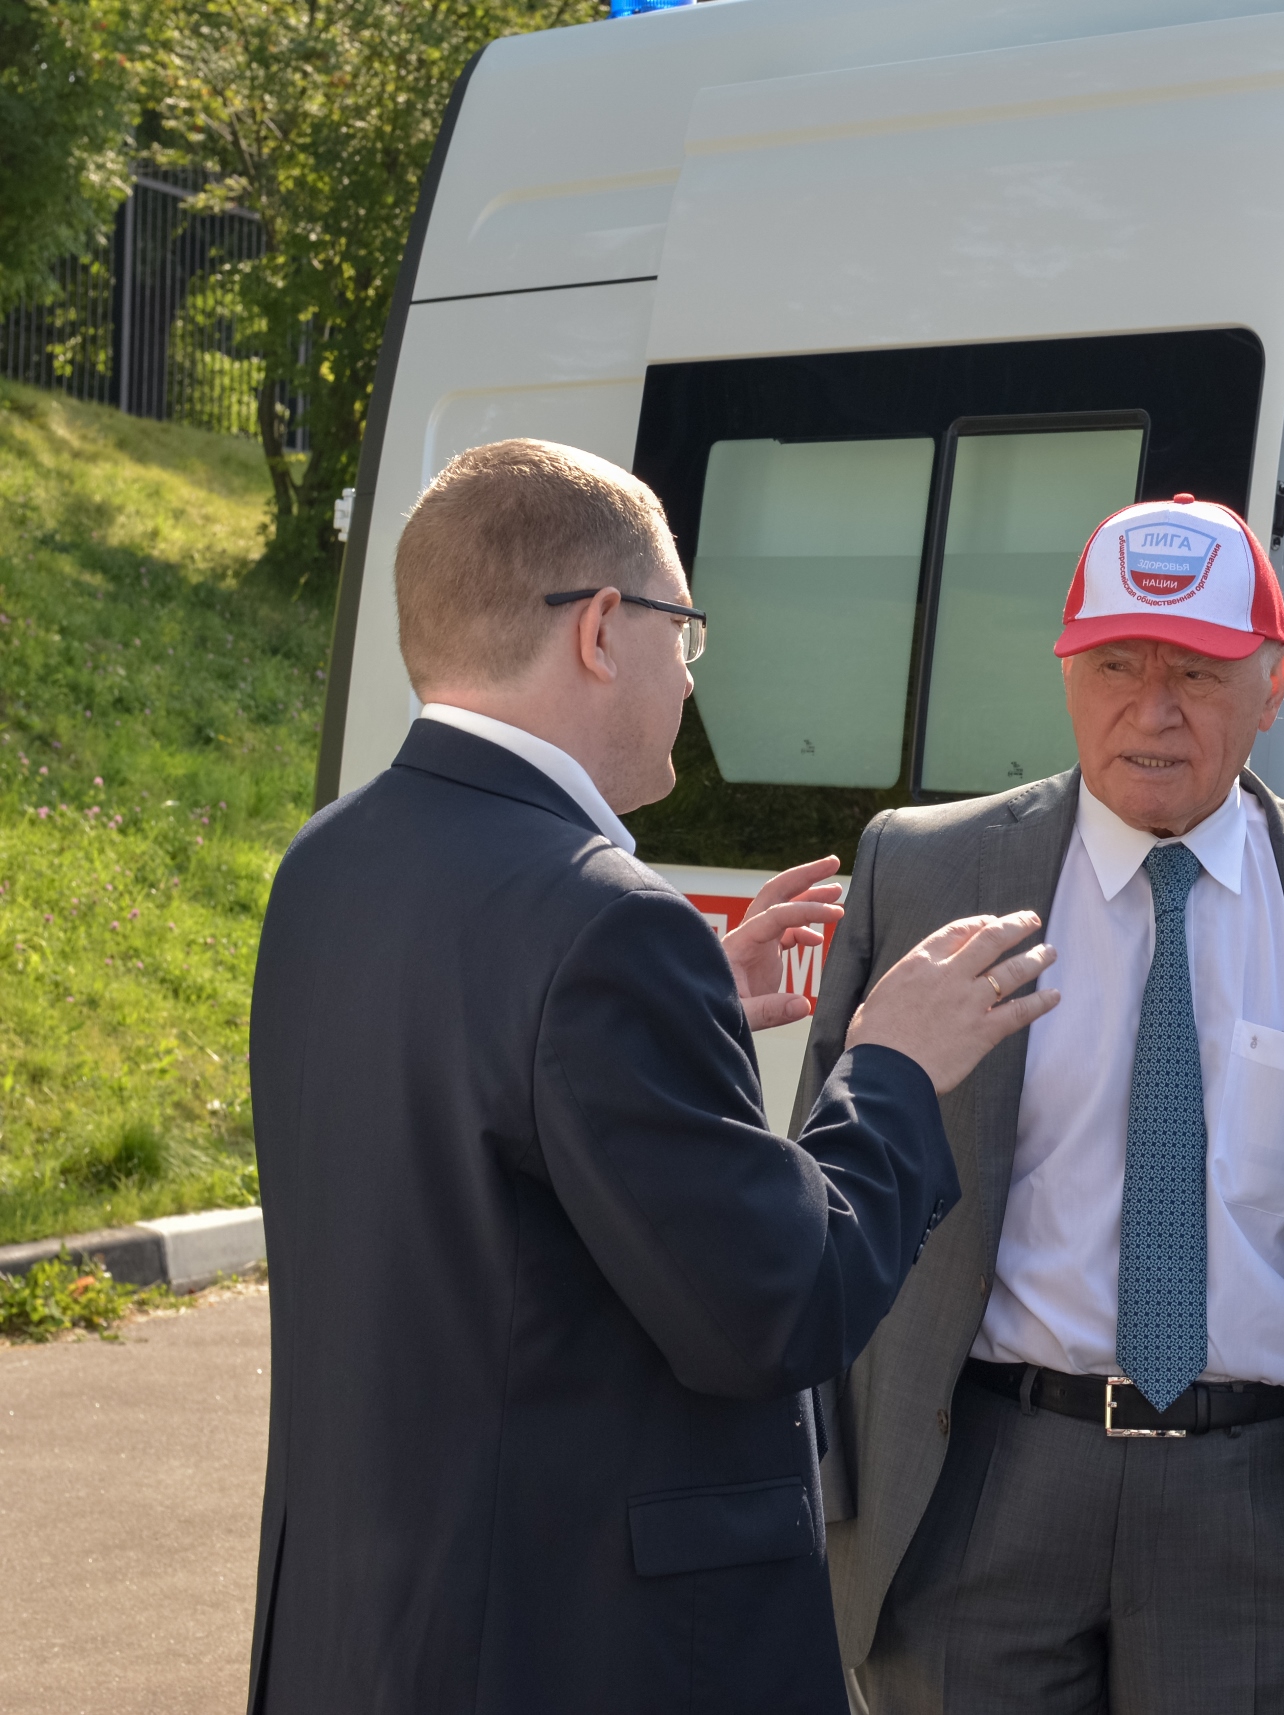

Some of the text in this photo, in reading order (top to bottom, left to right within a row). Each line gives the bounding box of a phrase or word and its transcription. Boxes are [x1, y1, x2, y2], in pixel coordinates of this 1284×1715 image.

[1141, 532, 1192, 551] ЛИГА
[1118, 534, 1222, 606] общероссийская общественная организация
[1137, 559, 1190, 571] ЗДОРОВЬЯ
[1142, 578, 1178, 589] НАЦИИ
